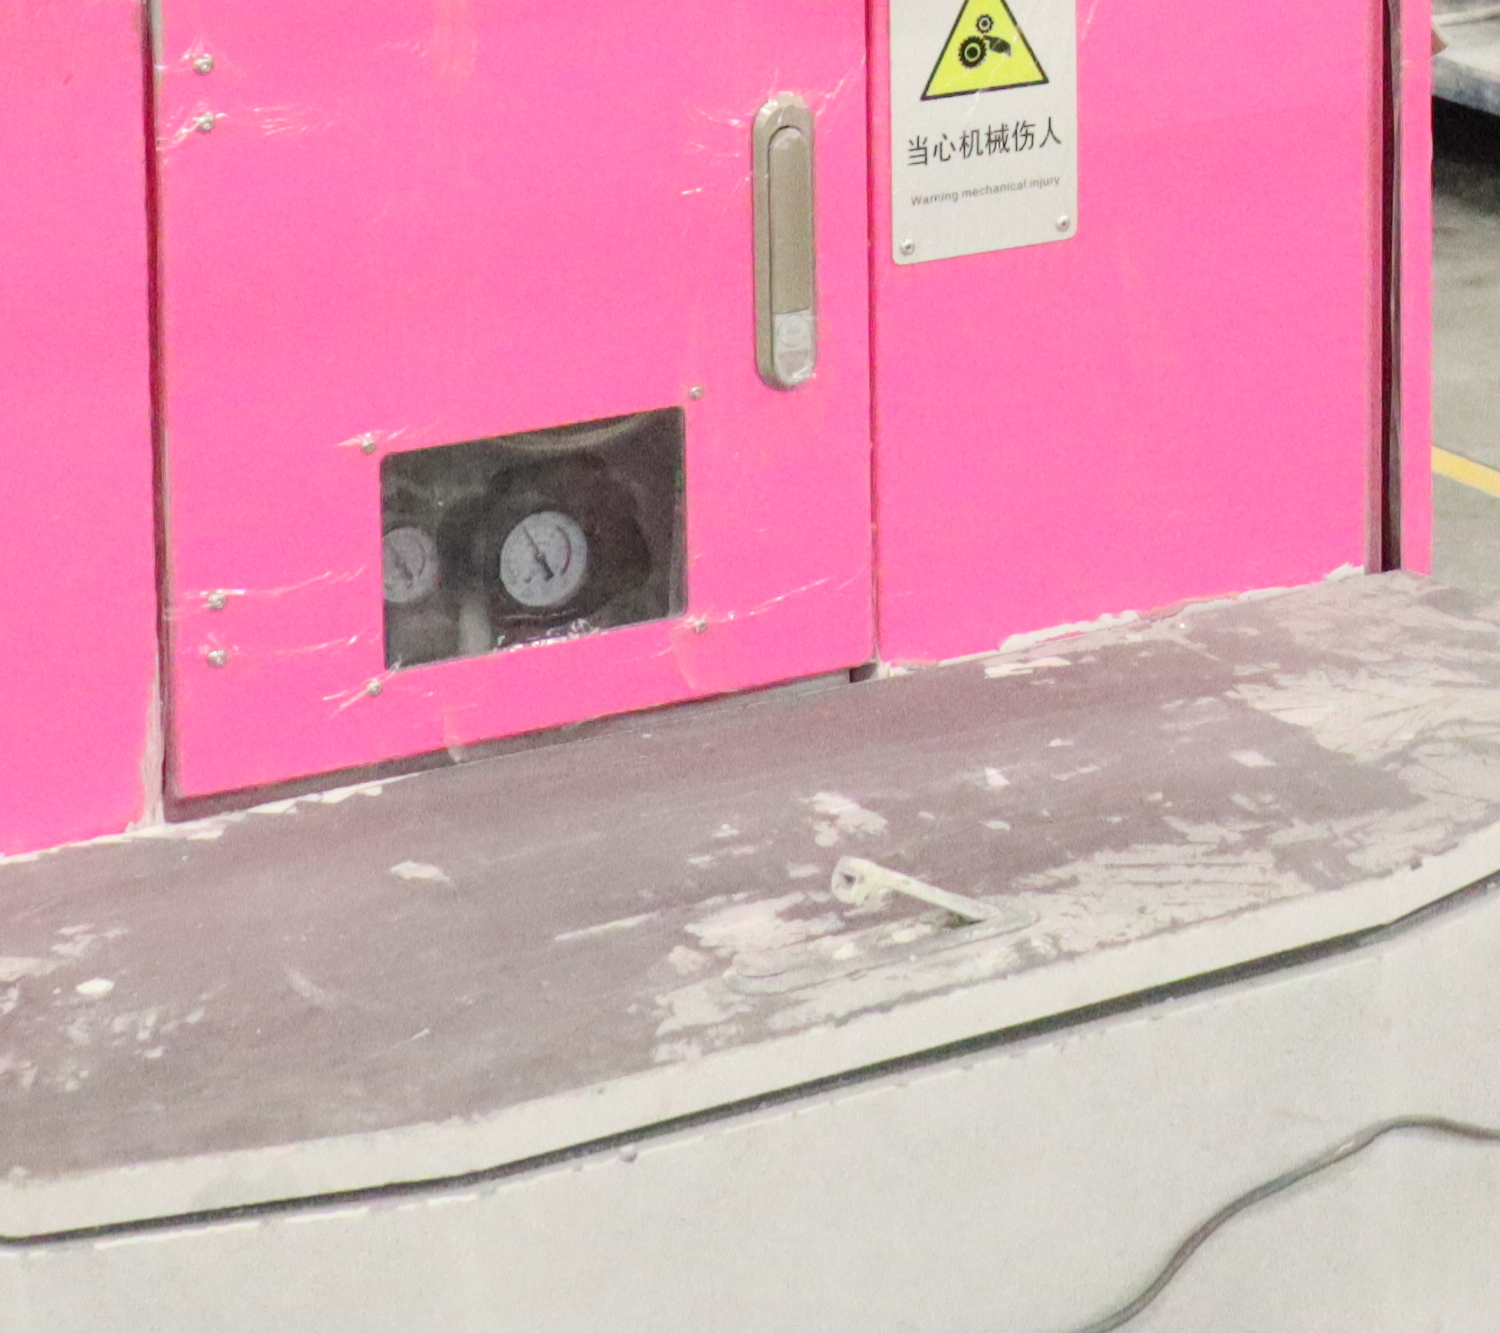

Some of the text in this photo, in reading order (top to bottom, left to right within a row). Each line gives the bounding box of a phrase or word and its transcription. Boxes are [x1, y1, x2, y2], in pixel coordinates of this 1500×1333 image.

[907, 116, 1062, 166] 当心机械伤人
[911, 175, 1061, 207] Warning mechanical injury
